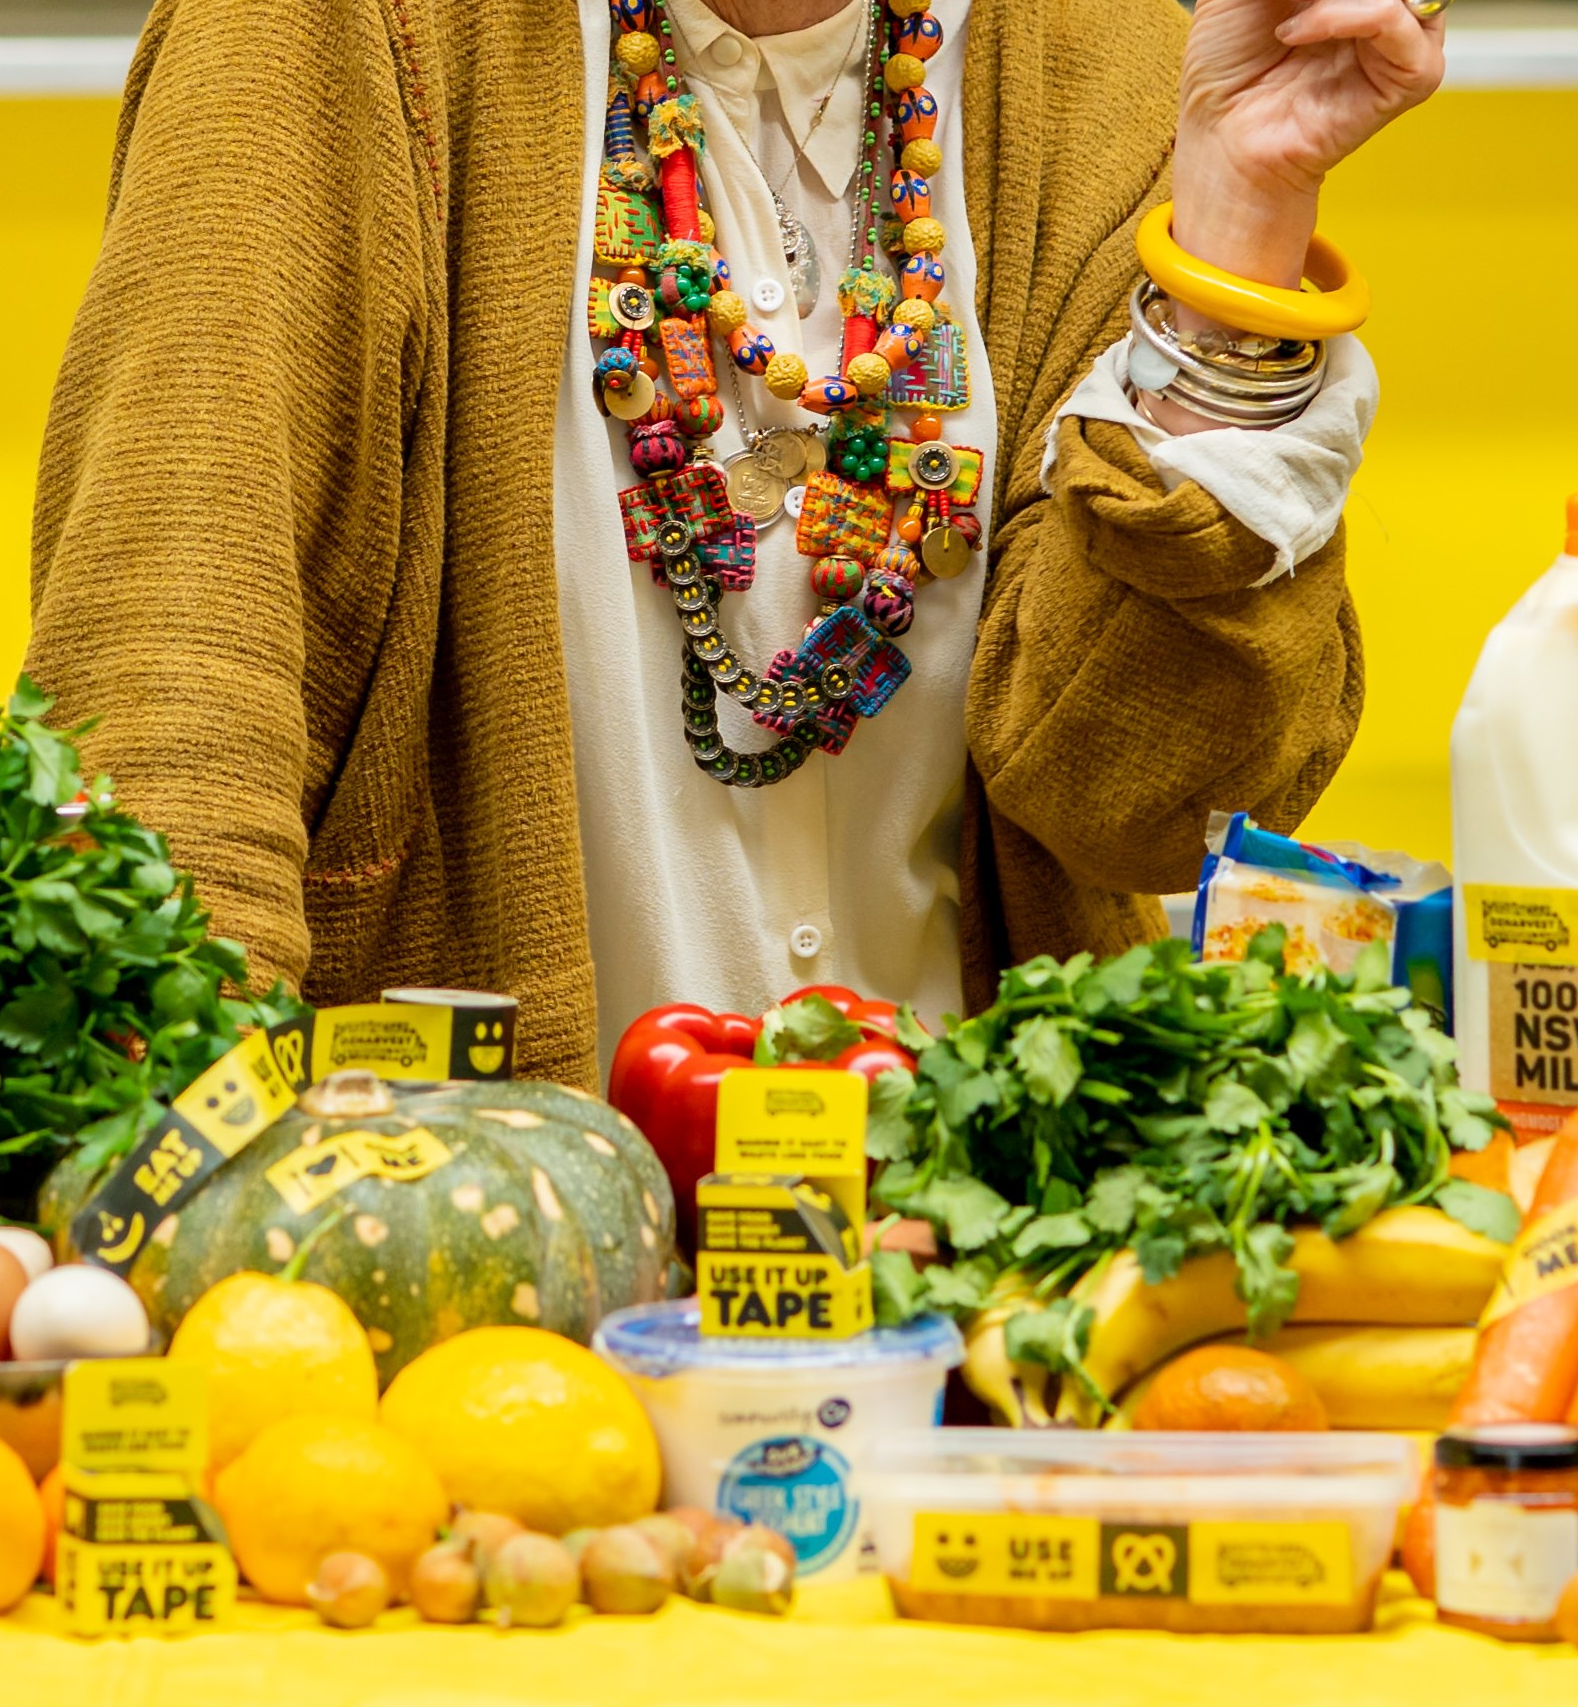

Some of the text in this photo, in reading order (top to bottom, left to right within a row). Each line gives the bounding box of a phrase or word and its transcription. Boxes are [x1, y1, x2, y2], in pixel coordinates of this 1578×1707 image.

[133, 1128, 190, 1196] EAT
[710, 1266, 829, 1285] USE IT UP
[710, 1289, 834, 1329] TAPE
[1009, 1538, 1072, 1562] USE
[98, 1559, 214, 1577] USE IT UP
[98, 1585, 217, 1622] TAPE
